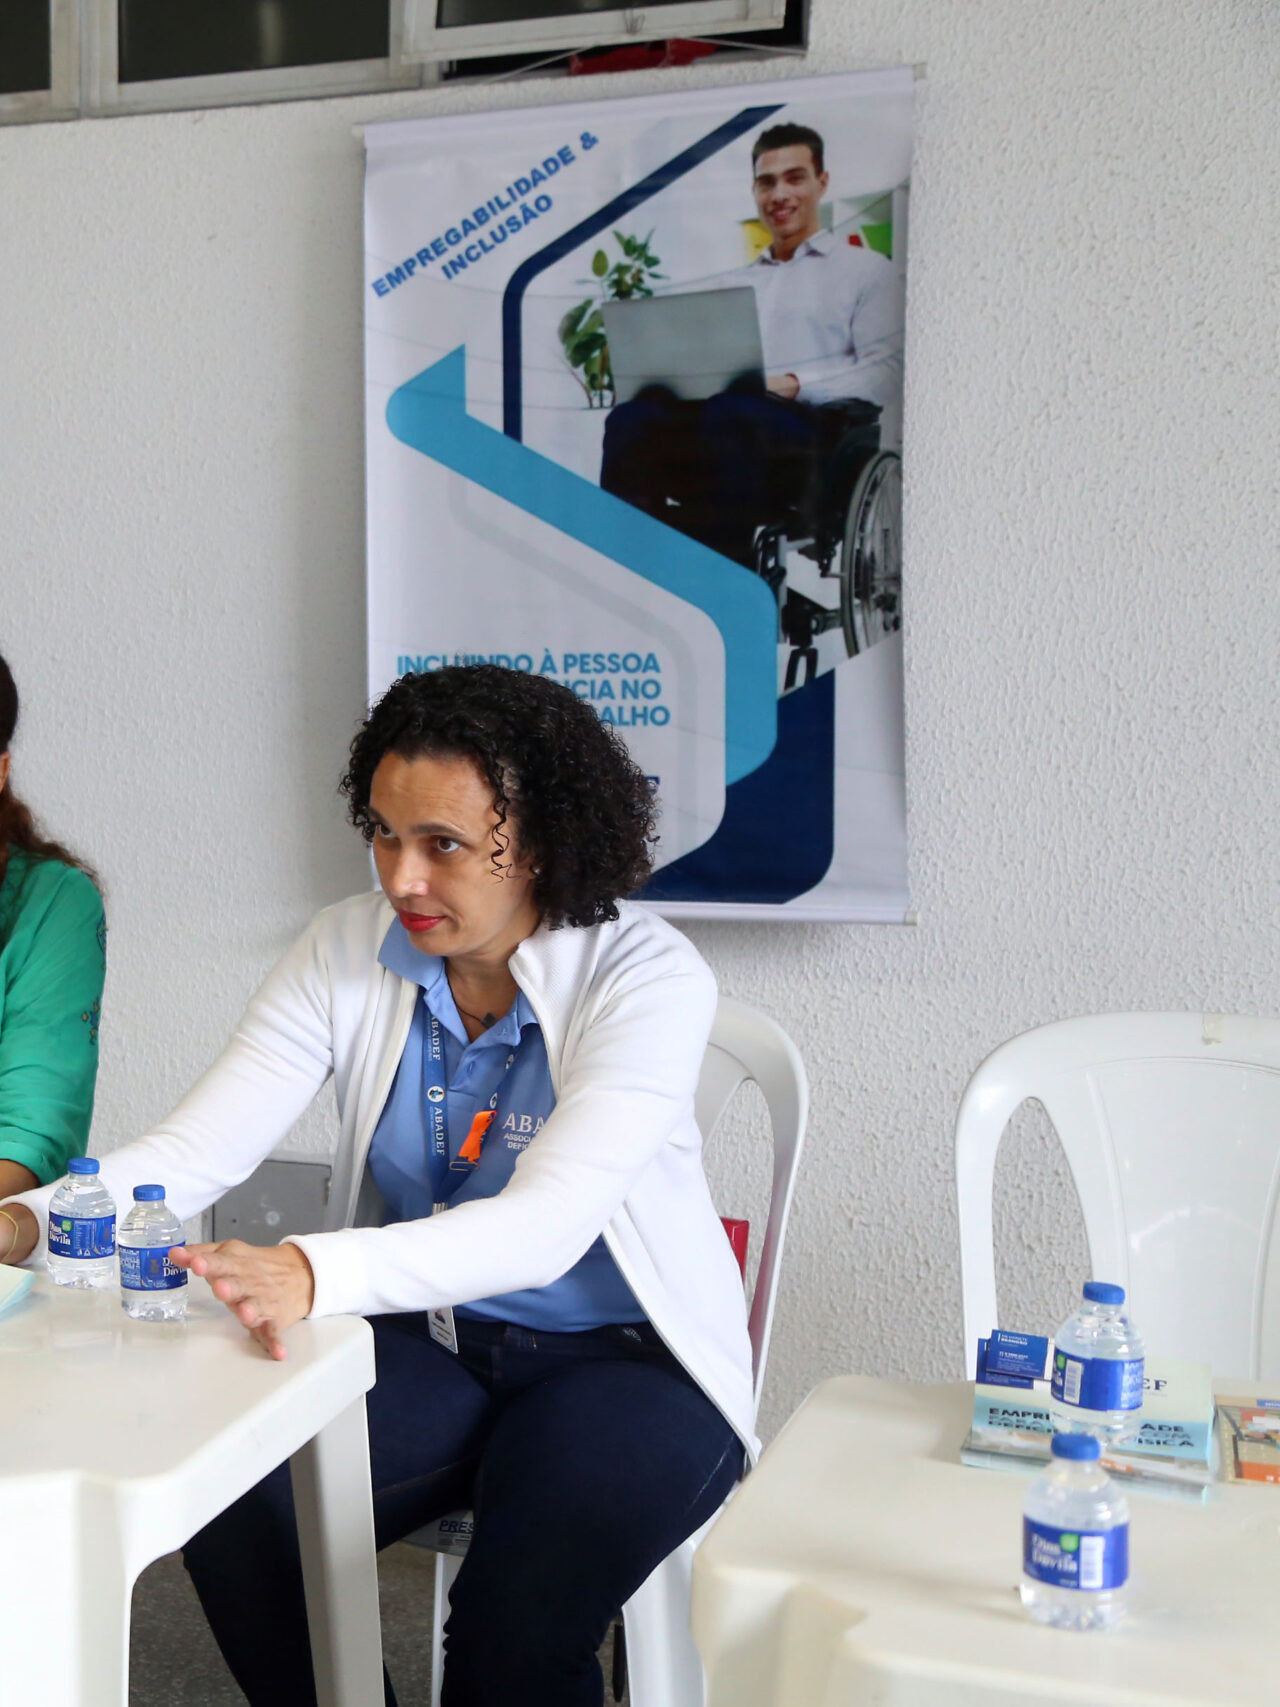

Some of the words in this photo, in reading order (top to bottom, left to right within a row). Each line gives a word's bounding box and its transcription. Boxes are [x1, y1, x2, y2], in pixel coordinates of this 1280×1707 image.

[371, 145, 576, 298] EMPREGABILIDADE
[579, 131, 599, 151] &
[441, 194, 553, 280] INCLUSÃO
[540, 648, 557, 674] À
[563, 653, 661, 674] PESSOA
[565, 679, 615, 700] CIA
[621, 679, 661, 700] NO
[434, 1106, 445, 1156] ABADEF
